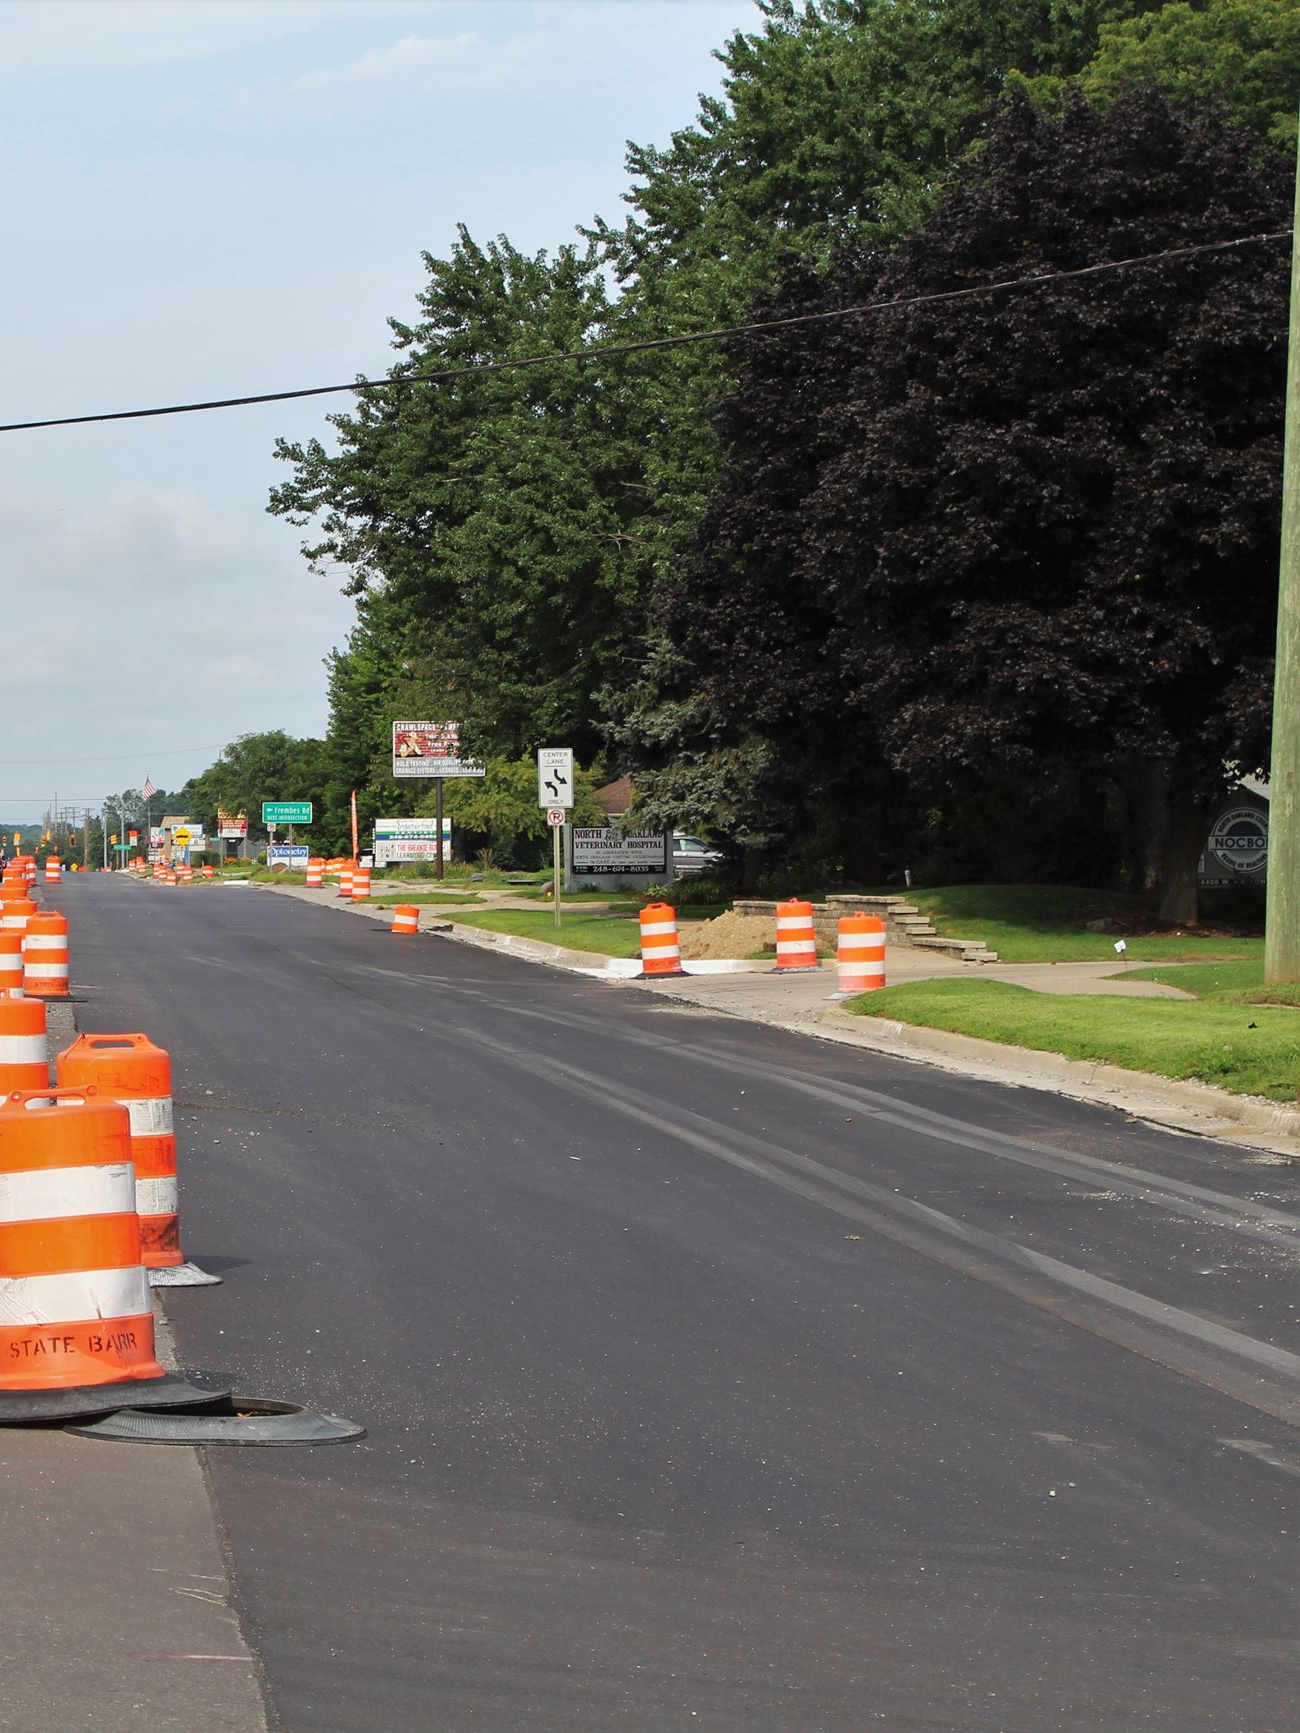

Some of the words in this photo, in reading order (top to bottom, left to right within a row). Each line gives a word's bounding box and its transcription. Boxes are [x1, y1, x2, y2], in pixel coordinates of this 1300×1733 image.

[396, 723, 436, 731] CRAWLSPACE
[574, 829, 602, 839] NORTH
[575, 841, 623, 849] VETERINARY
[627, 841, 663, 849] HOSPITAL
[1215, 837, 1267, 848] NOCBO
[593, 865, 649, 873] 248-674-8035
[10, 1336, 76, 1358] STATE
[88, 1332, 138, 1353] BARR
